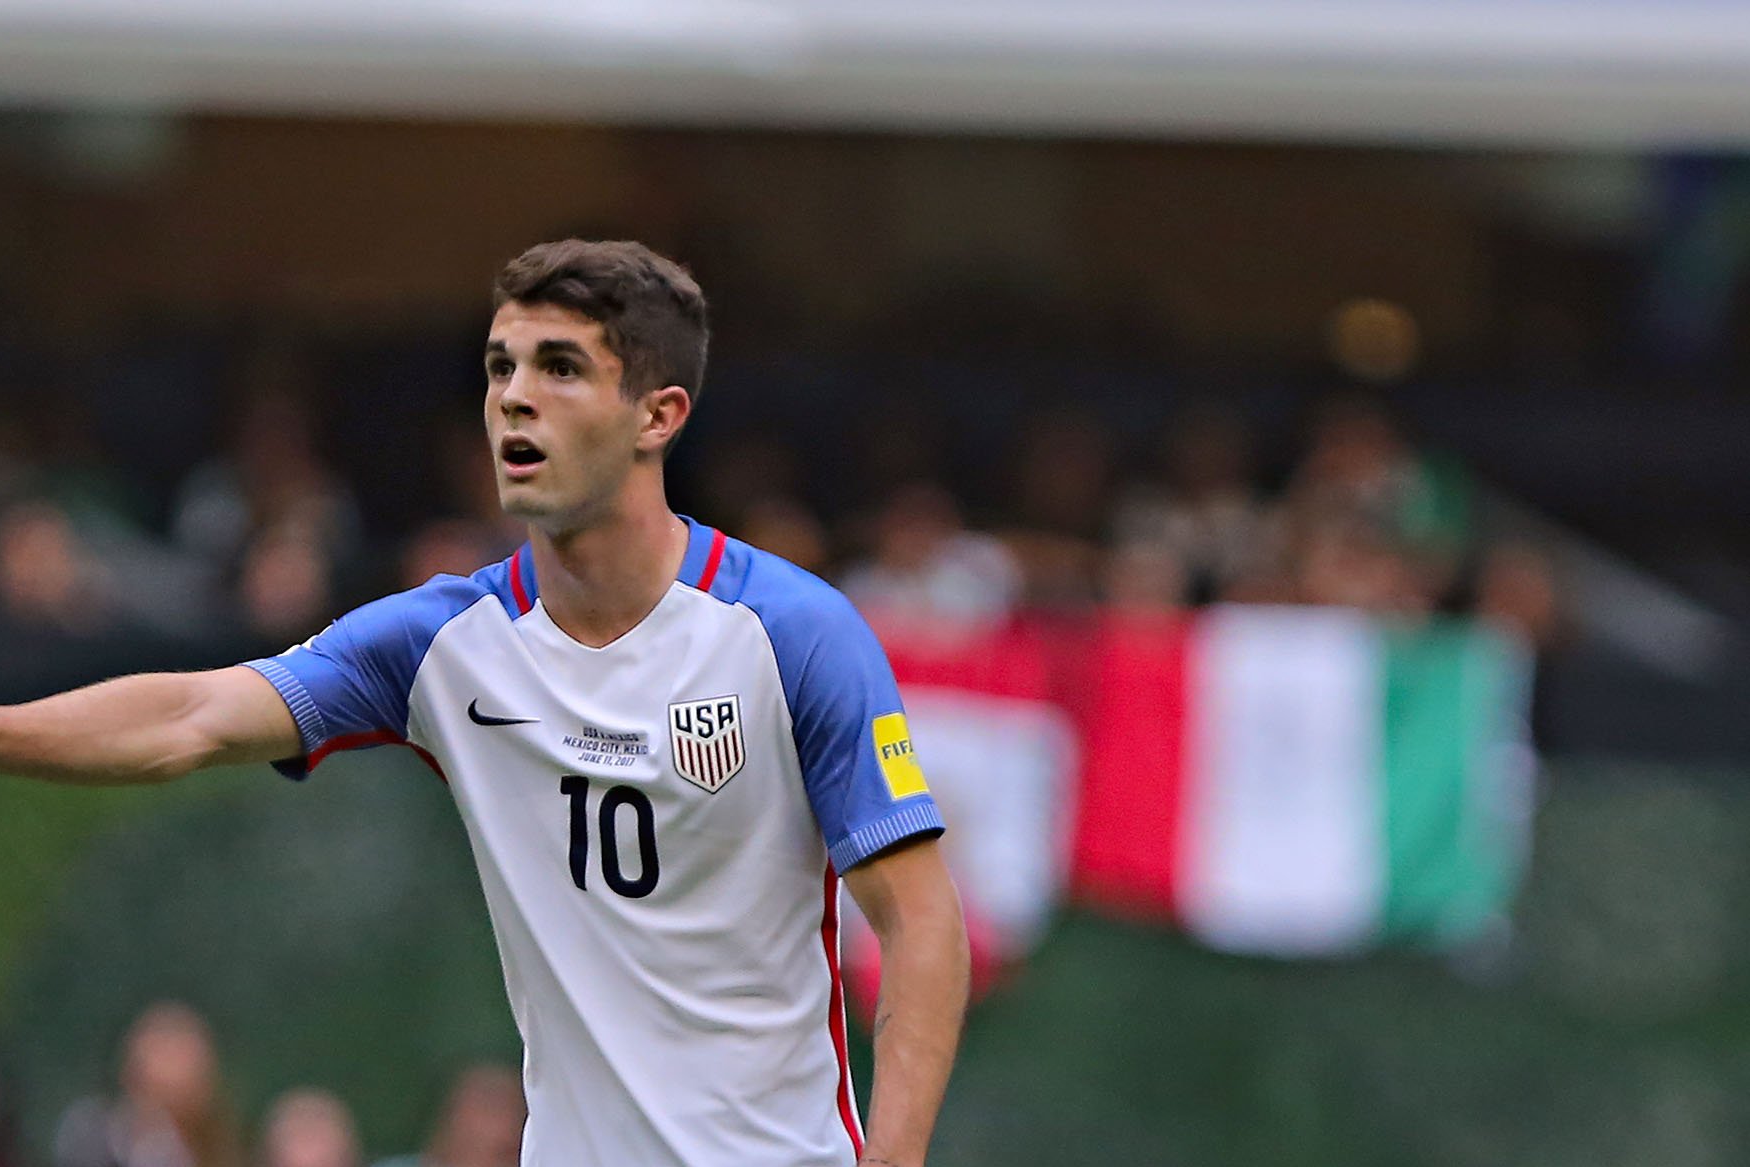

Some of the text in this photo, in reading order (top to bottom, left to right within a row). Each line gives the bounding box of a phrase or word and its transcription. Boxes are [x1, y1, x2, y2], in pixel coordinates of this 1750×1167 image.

[675, 703, 733, 738] USA
[562, 735, 600, 752] MEXICO
[578, 752, 603, 764] JUNE
[614, 756, 636, 767] 2017
[560, 775, 660, 899] 10
